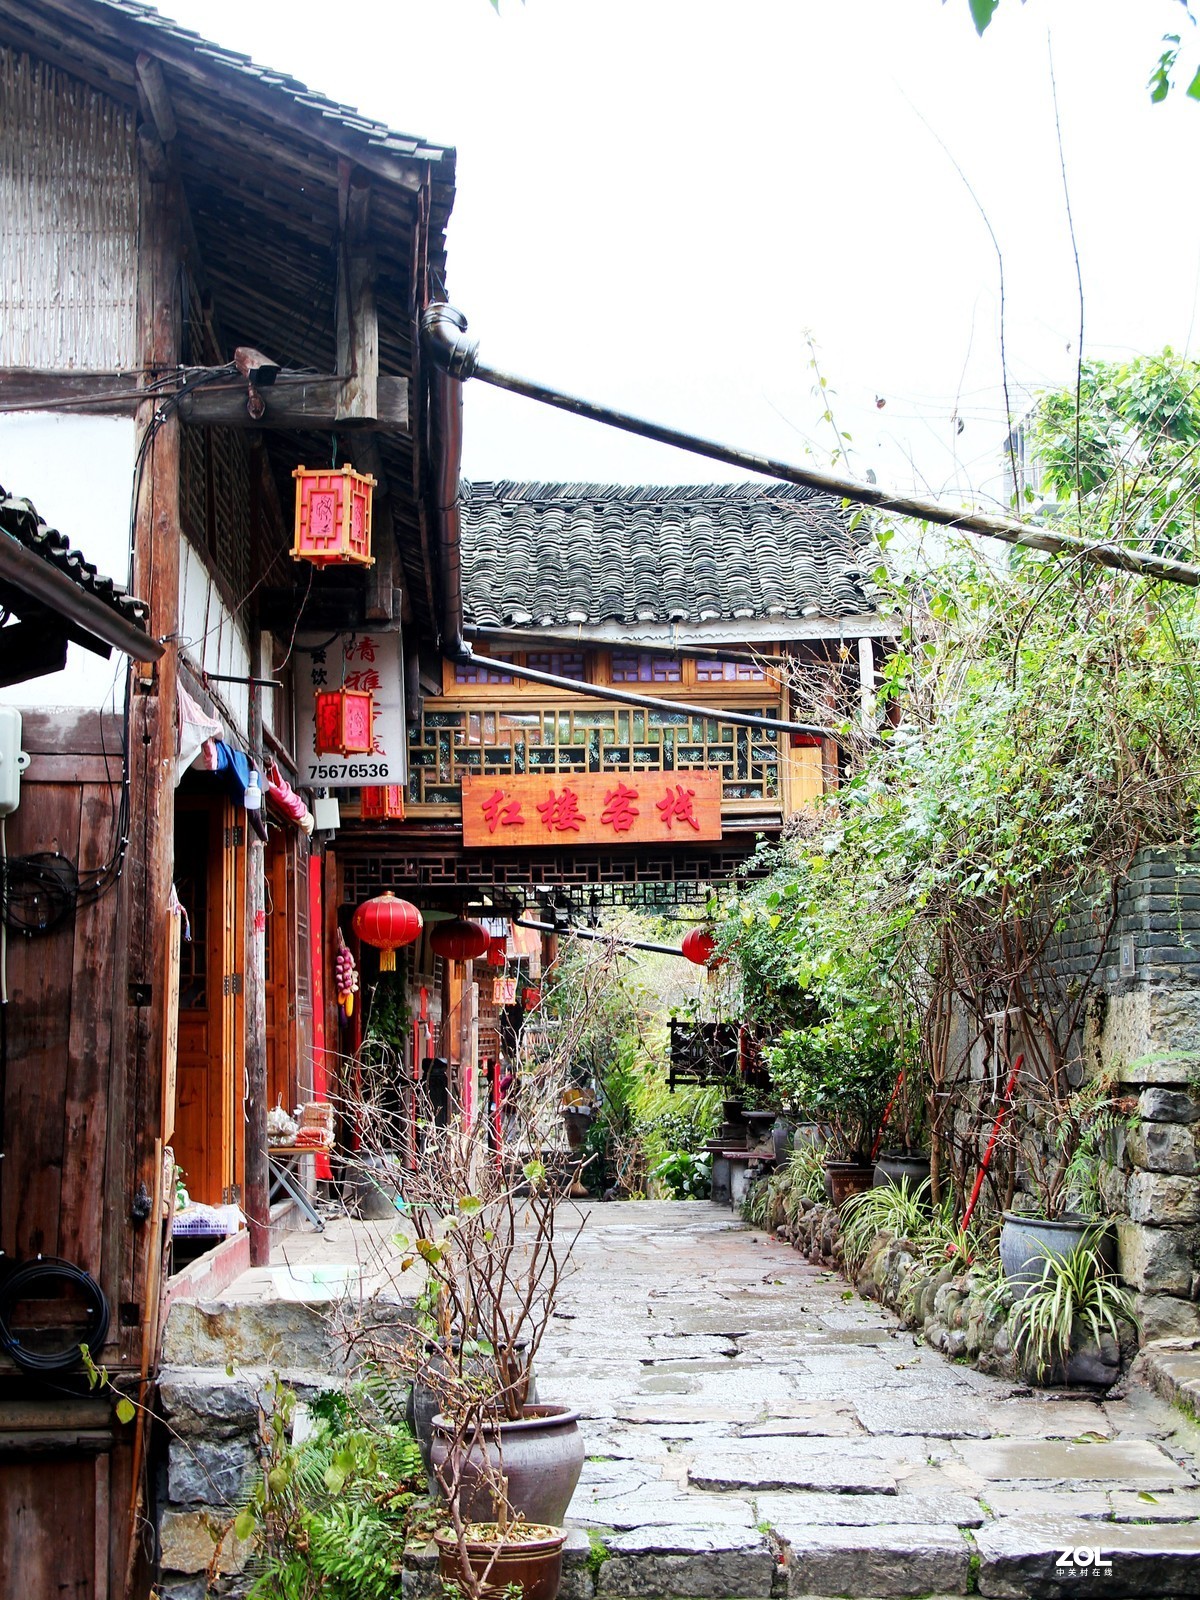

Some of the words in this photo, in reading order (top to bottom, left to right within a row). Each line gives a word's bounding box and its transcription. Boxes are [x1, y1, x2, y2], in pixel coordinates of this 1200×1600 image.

[308, 763, 389, 780] 75676536
[481, 783, 700, 833] 红楼客栈
